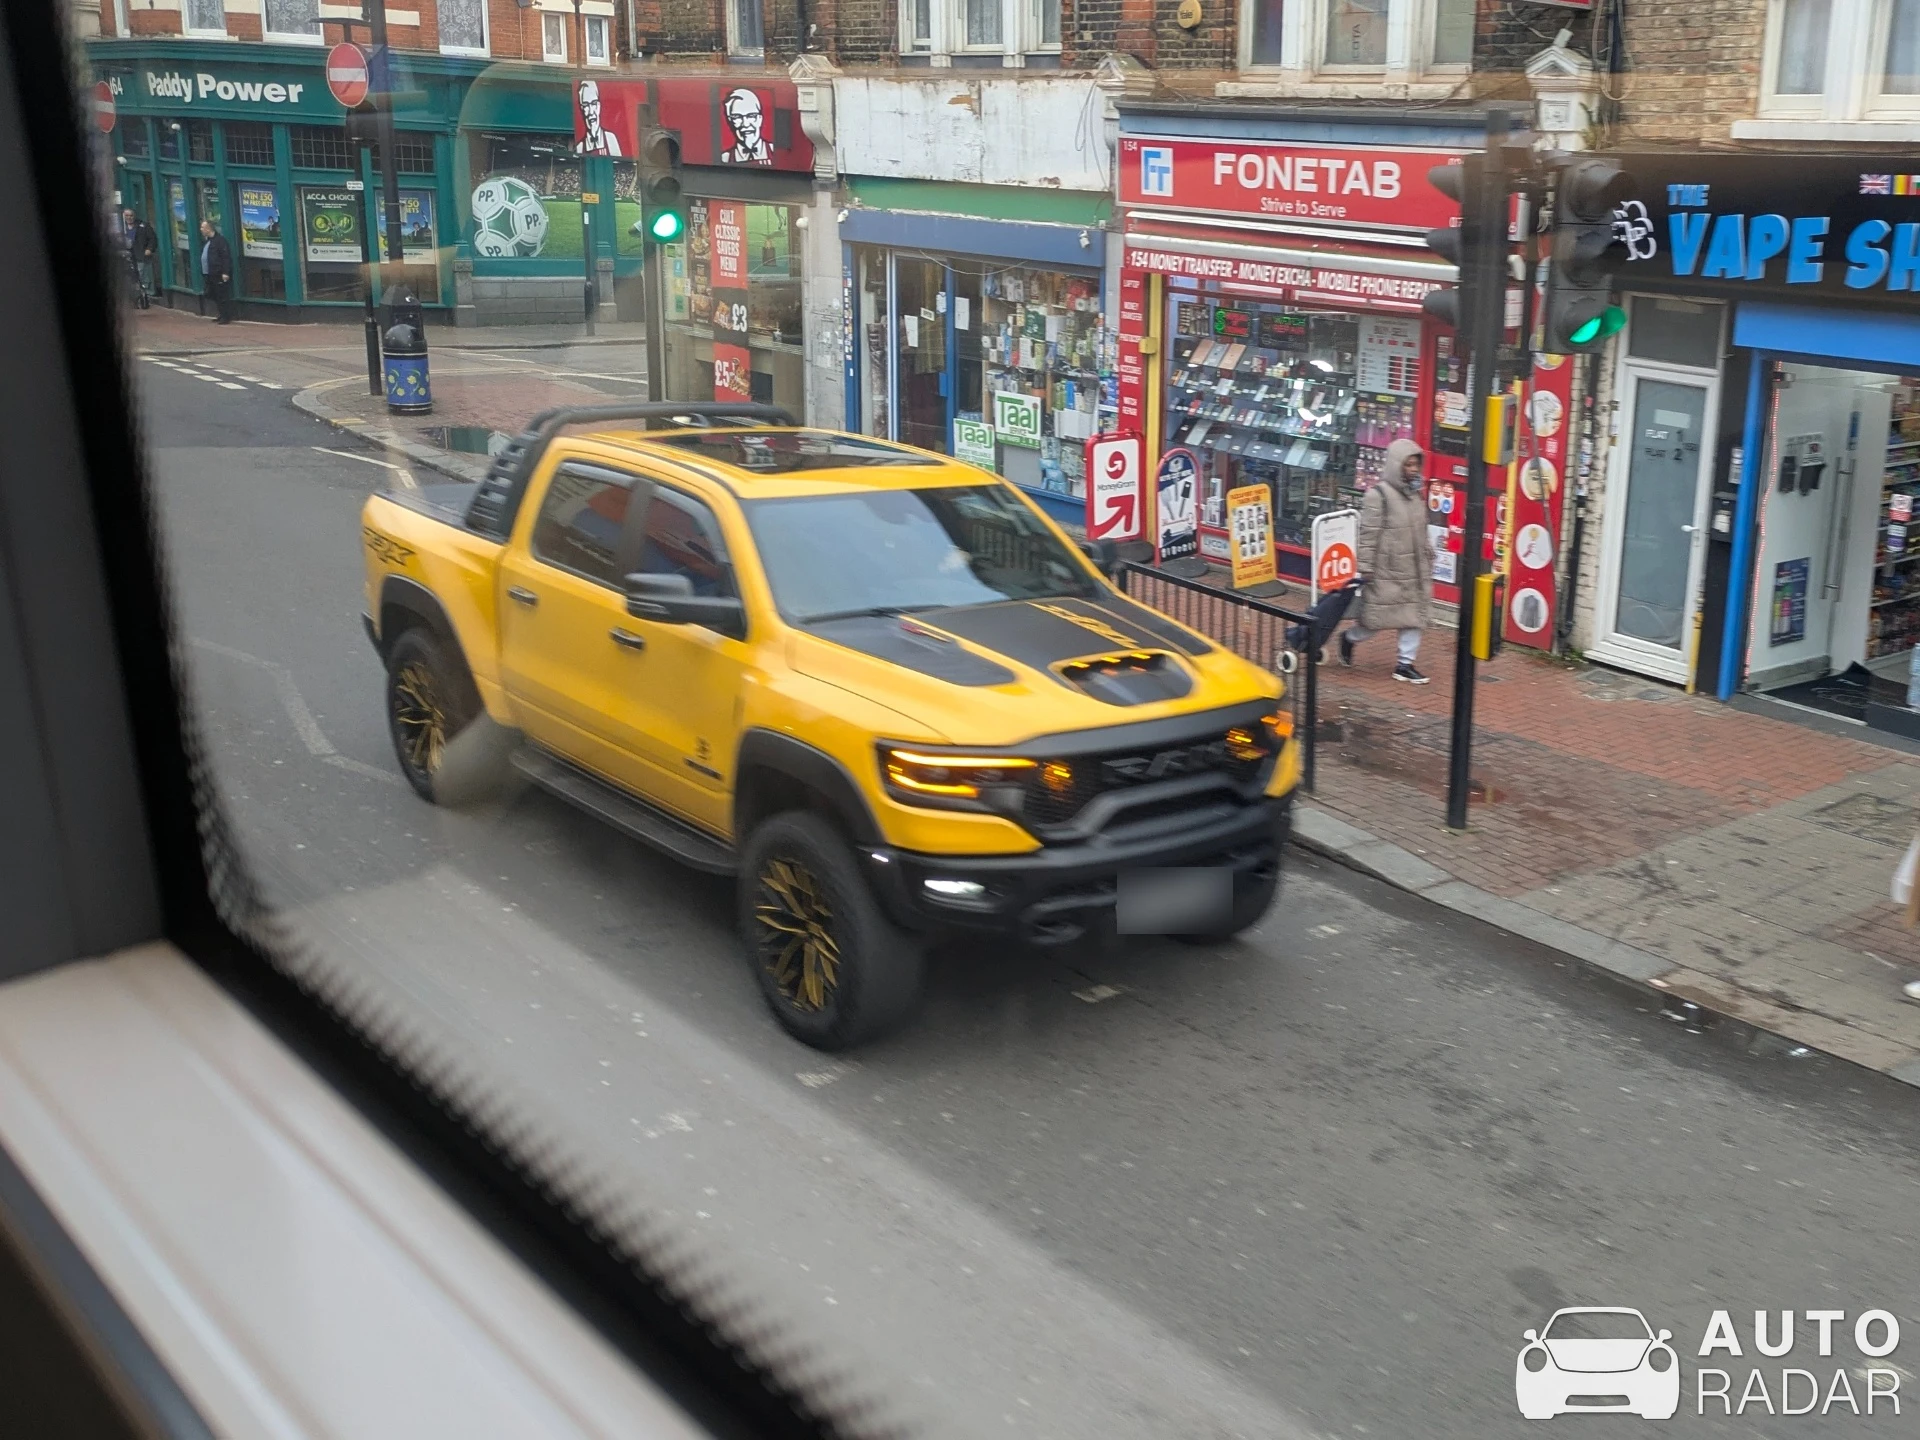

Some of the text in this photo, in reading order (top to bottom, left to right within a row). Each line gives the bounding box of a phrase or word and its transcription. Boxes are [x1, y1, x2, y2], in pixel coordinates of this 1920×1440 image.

[147, 71, 303, 103] Paddy Power
[1124, 141, 1138, 151] 154
[1213, 152, 1401, 199] FONETAB
[243, 191, 258, 200] WIN
[328, 193, 355, 201] CHOICE
[478, 190, 495, 202] PP.
[1666, 184, 1710, 206] THE
[1261, 197, 1346, 217] Strive to Serve
[525, 213, 541, 230] PP.
[720, 209, 735, 224] CULT
[715, 224, 740, 241] CLASSIC
[716, 240, 740, 256] SAVERS
[1667, 212, 1830, 284] VAPE
[720, 255, 737, 272] MENU
[1131, 251, 1148, 267] 154
[1149, 253, 1184, 272] MONEY
[1185, 257, 1233, 277] TRANSFER
[1238, 263, 1277, 283] MONEY
[1277, 267, 1311, 287] EXCHA
[1317, 271, 1359, 292] MOBILE
[1360, 276, 1400, 296] PHONE
[732, 303, 748, 332] £3
[996, 396, 1039, 435] Taaj
[954, 420, 993, 449] Taaj
[1645, 429, 1669, 440] FLAT
[1645, 447, 1683, 461] FLAT 2
[1097, 480, 1136, 491] MoneyGram
[1322, 551, 1353, 580] ria
